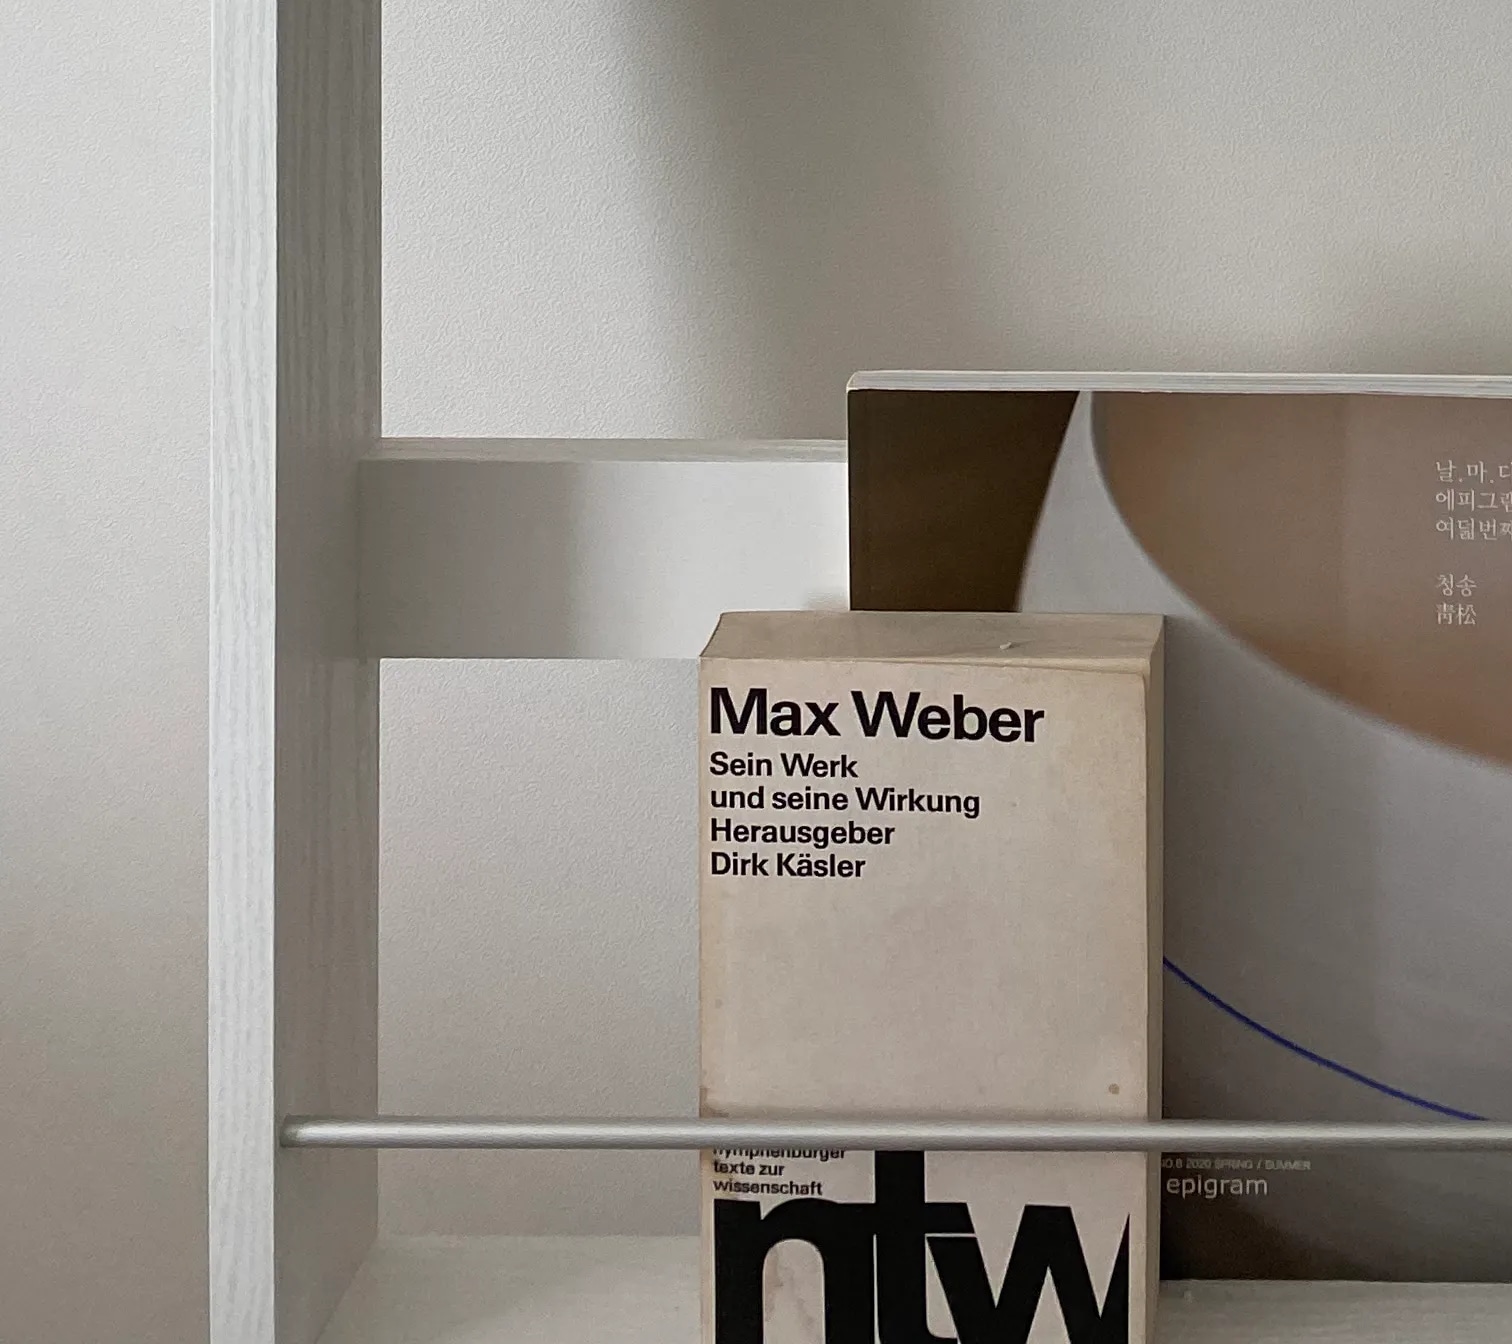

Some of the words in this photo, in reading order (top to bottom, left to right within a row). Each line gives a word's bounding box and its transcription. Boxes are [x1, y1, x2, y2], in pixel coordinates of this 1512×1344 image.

[1436, 574, 1477, 597] 청송
[710, 688, 841, 736] Max
[851, 691, 1045, 742] Weber
[710, 752, 772, 777] Sein
[781, 753, 858, 778] Werk
[711, 786, 764, 809] und
[772, 786, 848, 811] seine
[855, 787, 980, 818] Wirkung
[711, 818, 895, 848] Herausgeber
[711, 852, 768, 877] Dirk
[777, 853, 866, 878] Käsler
[713, 1160, 755, 1175] texte
[759, 1164, 785, 1176] zur
[1186, 1158, 1212, 1169] 2020
[713, 1178, 823, 1196] wissenschaft
[1166, 1174, 1268, 1200] epigram
[714, 1150, 1130, 1344] ntw
